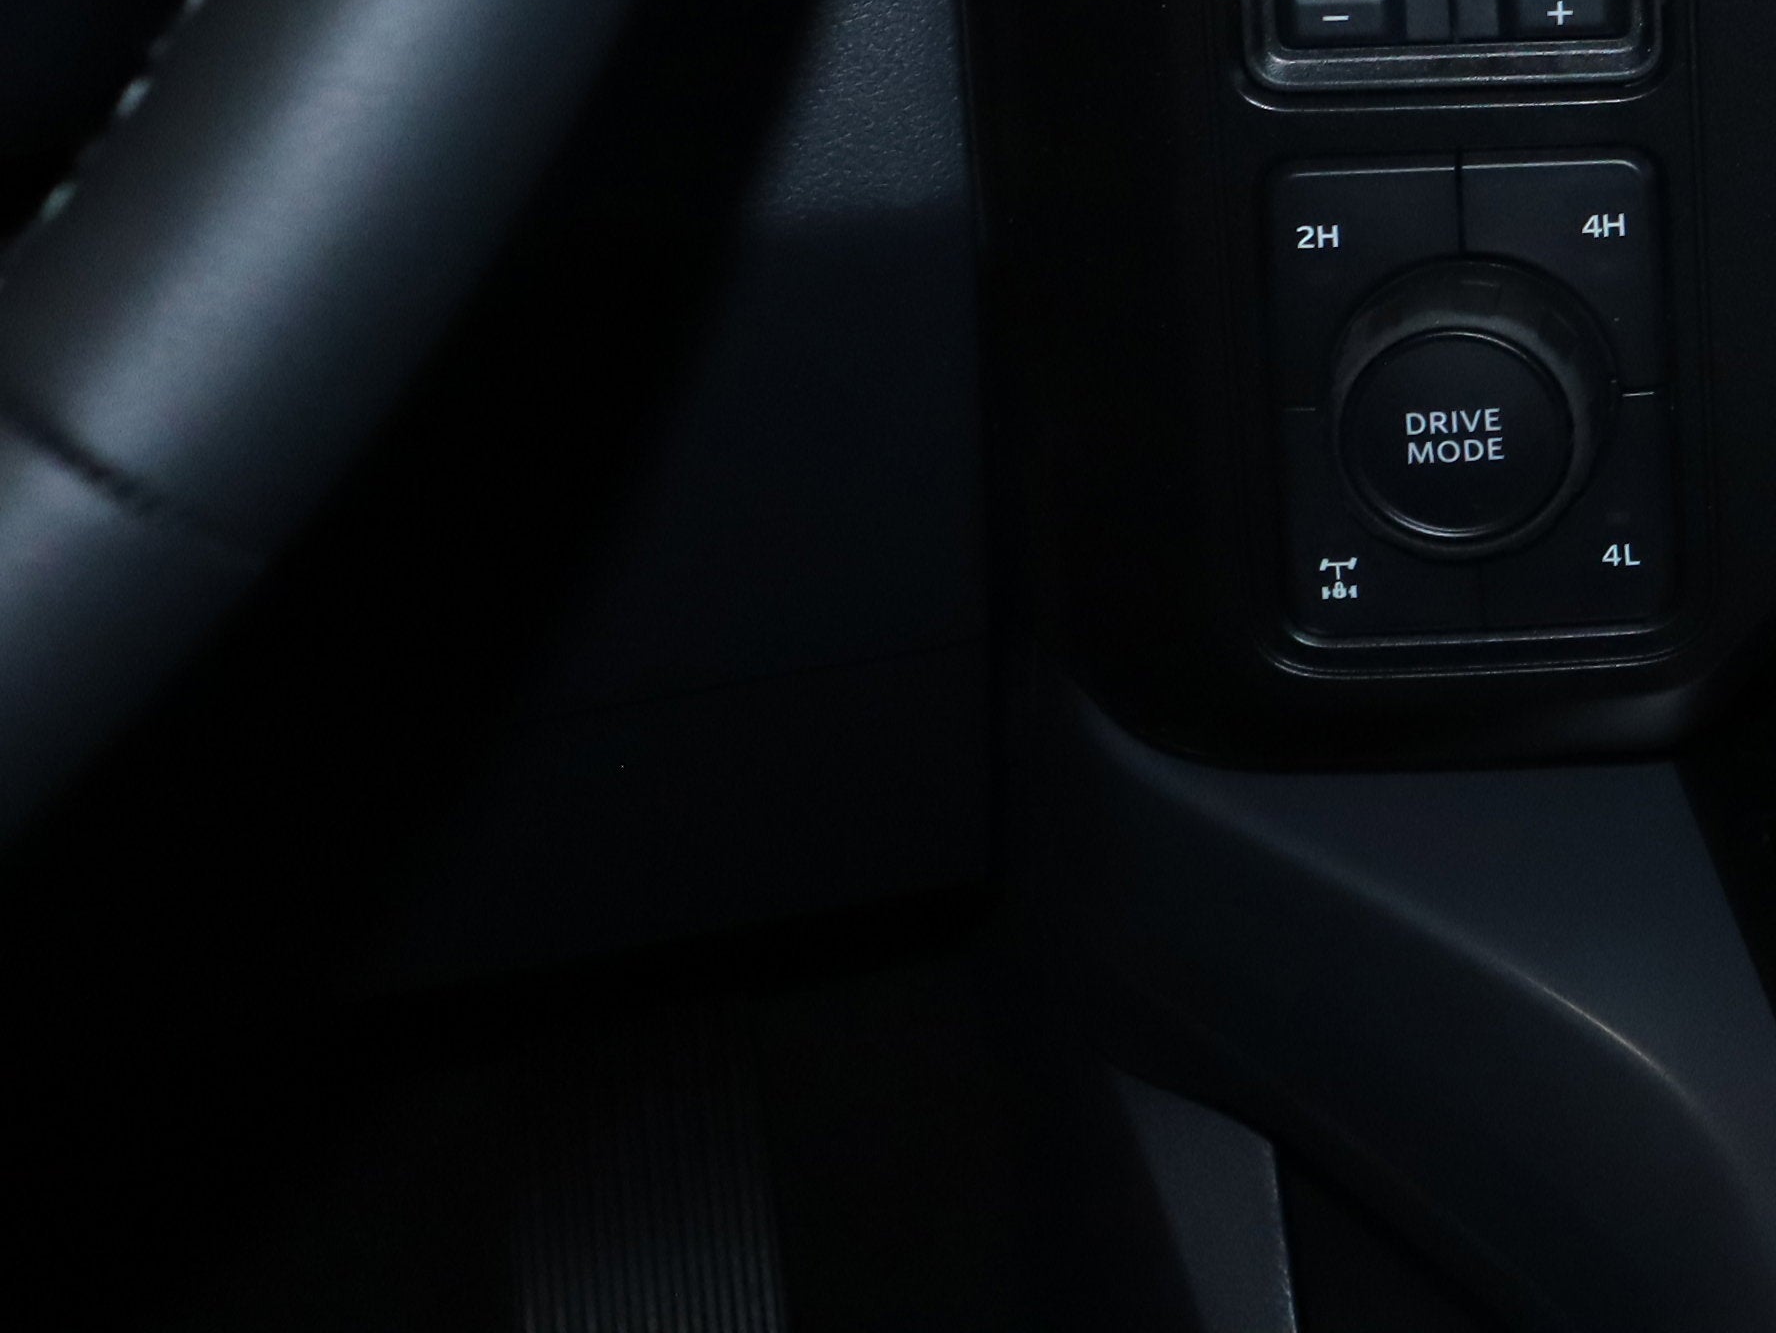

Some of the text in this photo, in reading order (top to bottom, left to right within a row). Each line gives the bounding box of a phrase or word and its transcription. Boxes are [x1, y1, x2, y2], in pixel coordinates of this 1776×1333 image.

[1297, 225, 1339, 248] 2H
[1582, 213, 1625, 237] 4H
[1405, 408, 1502, 434] DRIVE
[1407, 437, 1505, 464] MODE
[1602, 544, 1640, 566] 4L
